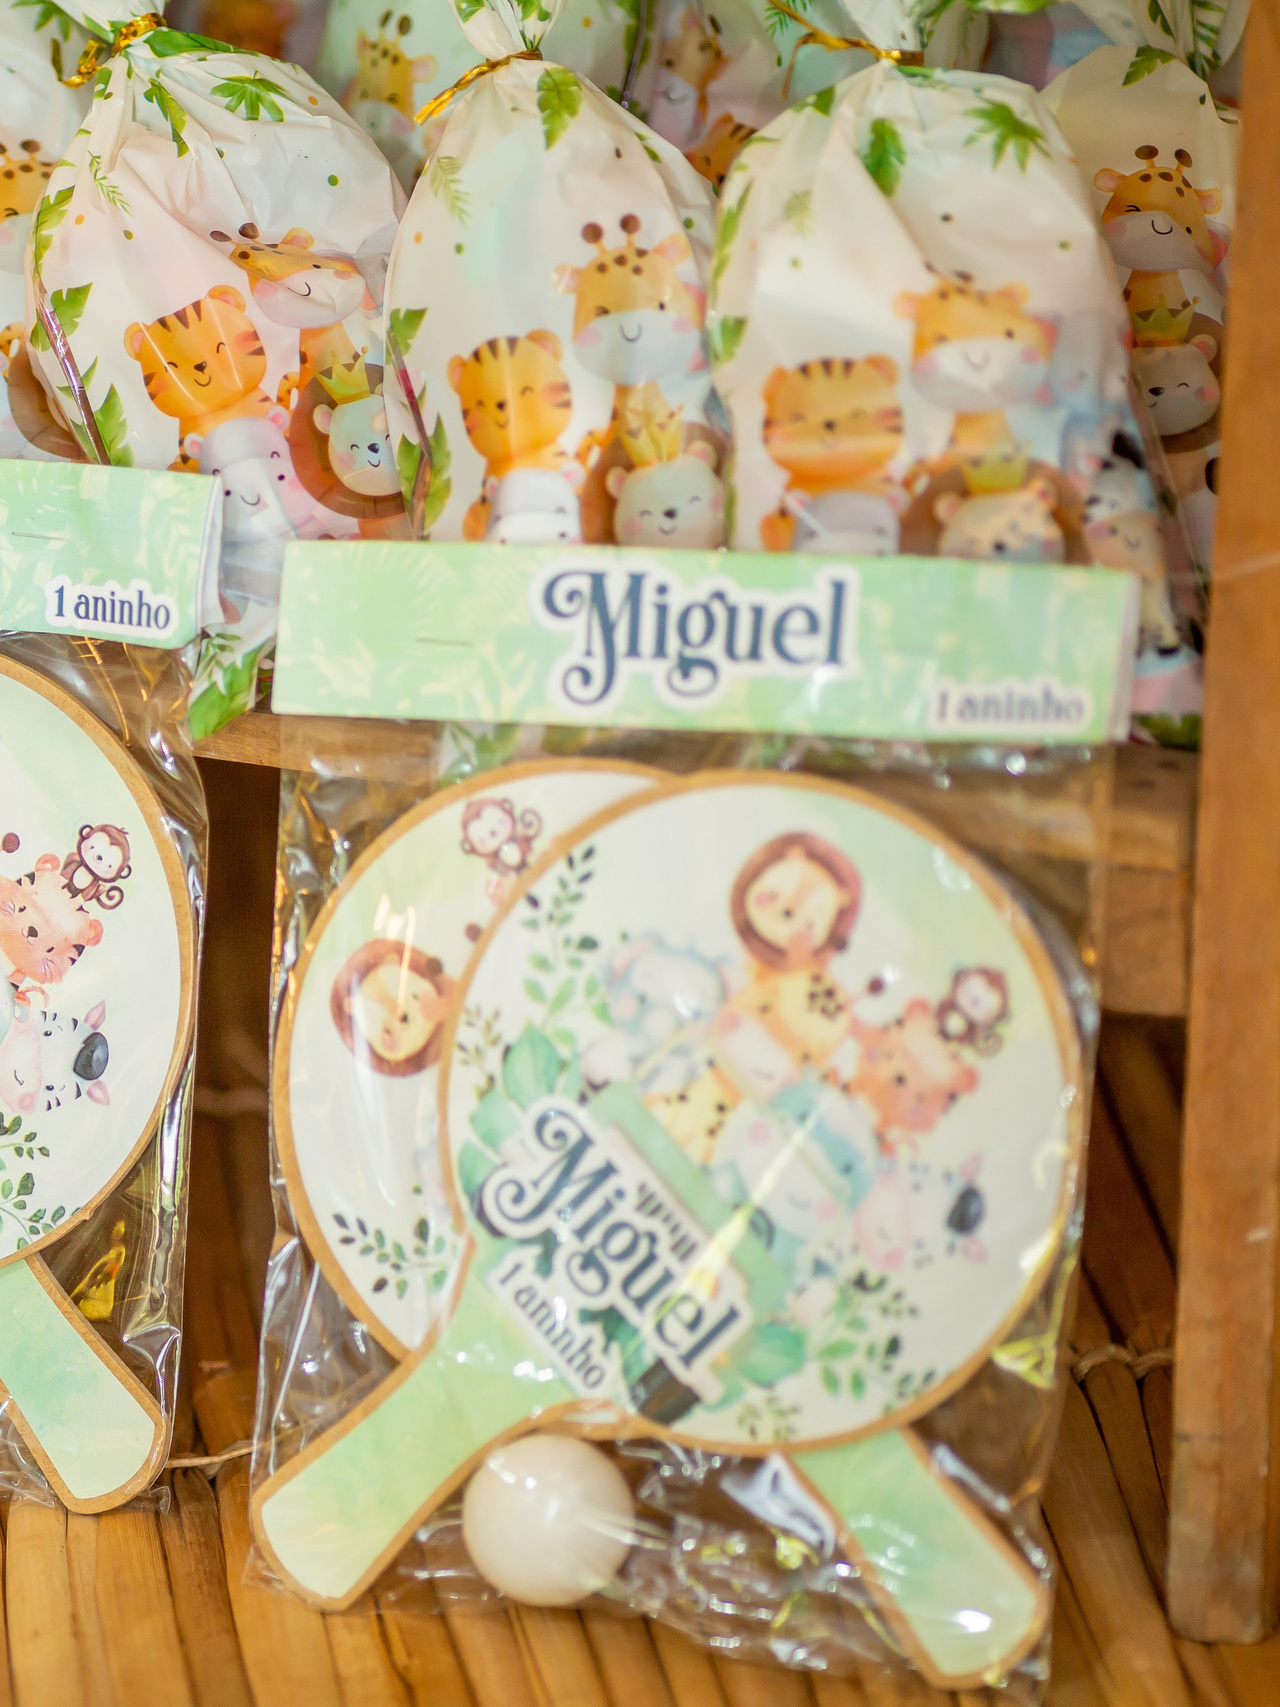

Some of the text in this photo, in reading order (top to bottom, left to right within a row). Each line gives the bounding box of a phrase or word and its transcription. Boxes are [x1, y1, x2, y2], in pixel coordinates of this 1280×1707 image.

[54, 585, 171, 630] 1 aninho
[543, 571, 847, 704] Miguel
[956, 685, 1085, 725] aninho
[495, 1109, 741, 1368] Miguel
